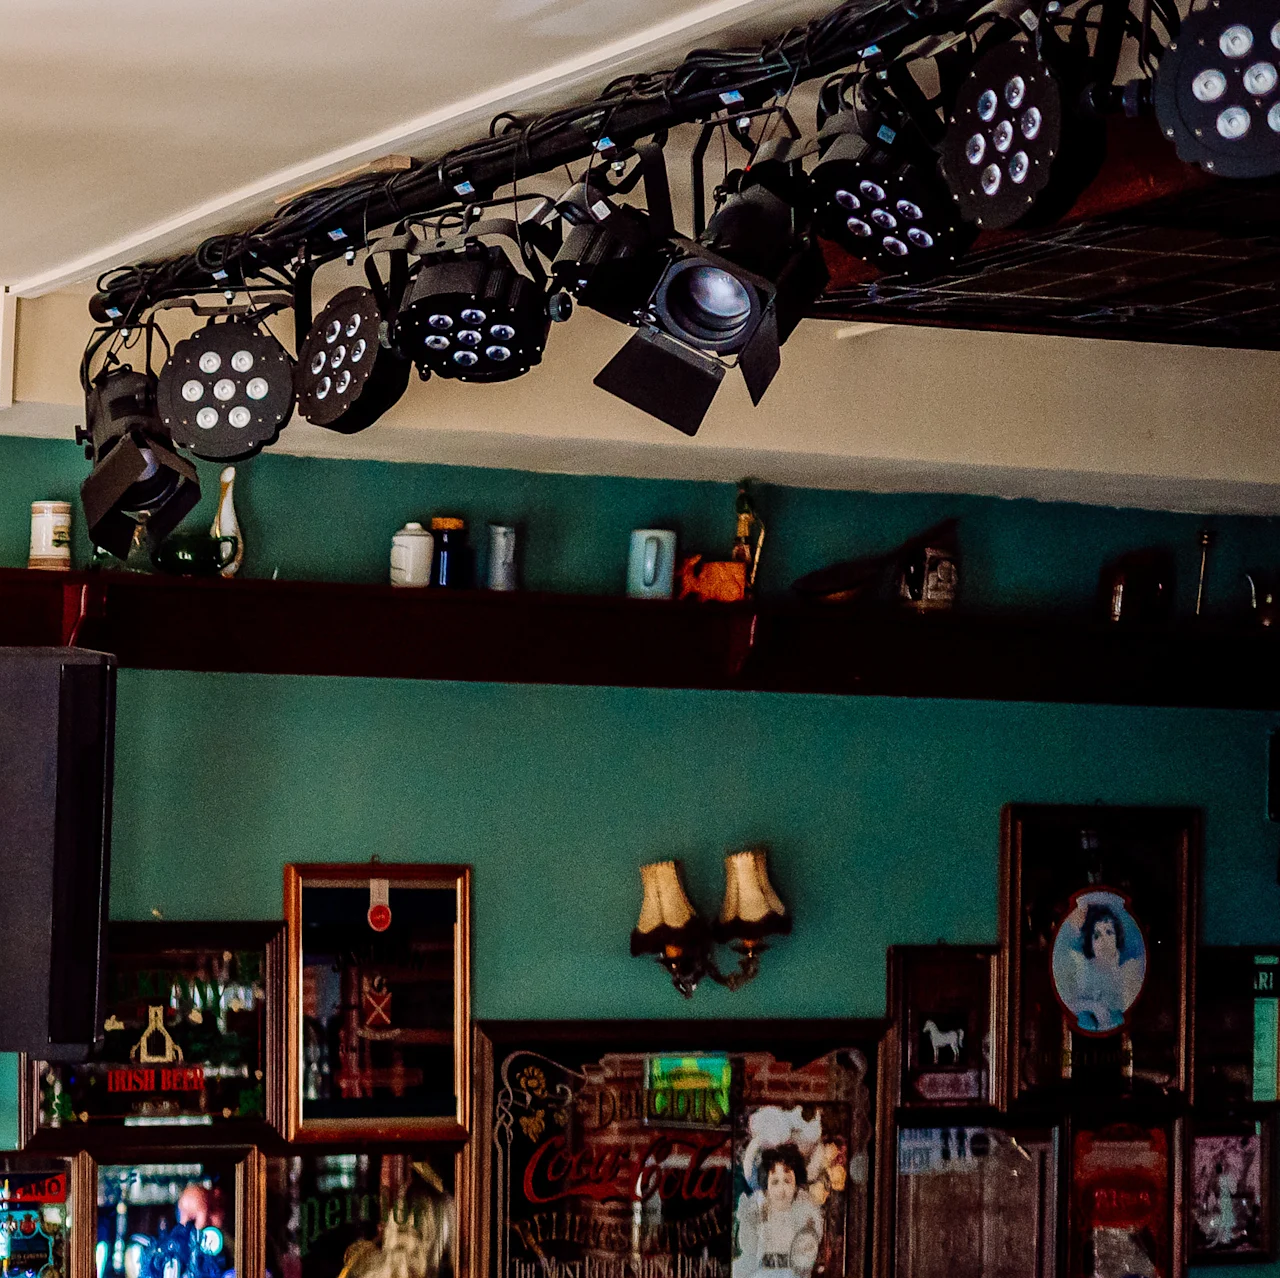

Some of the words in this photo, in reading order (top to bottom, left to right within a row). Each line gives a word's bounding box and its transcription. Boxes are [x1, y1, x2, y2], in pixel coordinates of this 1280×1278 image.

[107, 1068, 156, 1093] IRISH
[160, 1067, 205, 1092] BEER
[594, 1086, 727, 1128] DELICIOUS
[631, 1203, 728, 1252] ATIGUE
